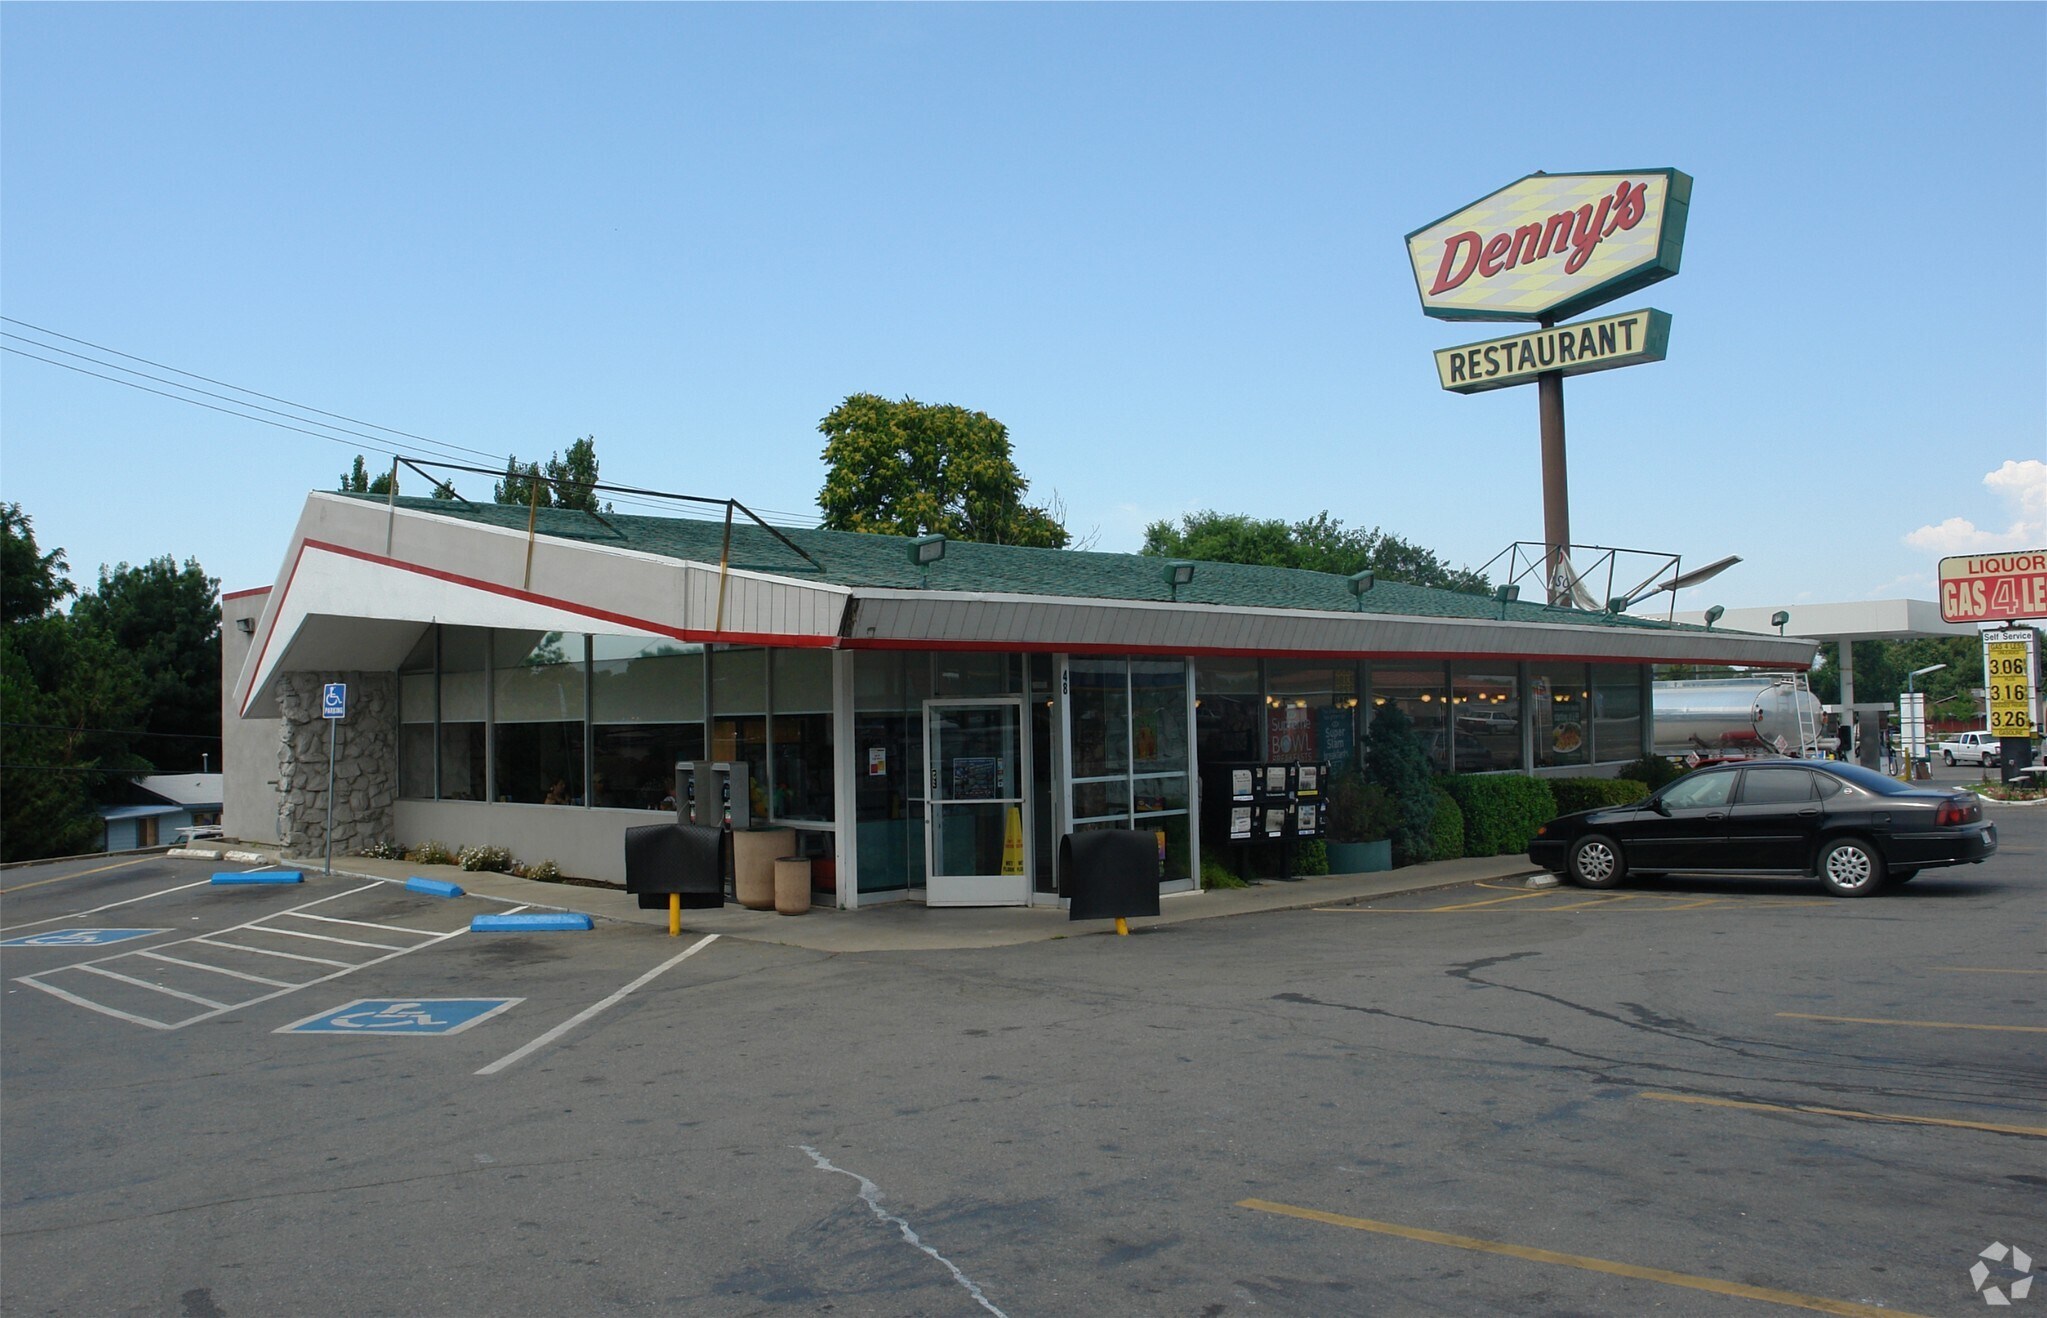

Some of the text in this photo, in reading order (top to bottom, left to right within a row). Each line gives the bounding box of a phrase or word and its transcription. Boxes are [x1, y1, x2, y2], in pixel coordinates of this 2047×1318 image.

[1428, 180, 1647, 296] Denny's
[1449, 318, 1638, 383] RESTAURANT
[1968, 555, 2046, 574] LIQUOR
[1943, 577, 2047, 618] GAS 4 LE
[1984, 632, 2032, 641] Self Service
[1991, 684, 2024, 701] 3.16
[1271, 718, 1311, 734] Supreme
[1992, 711, 2026, 727] 3.26
[1272, 733, 1312, 754] BOWL
